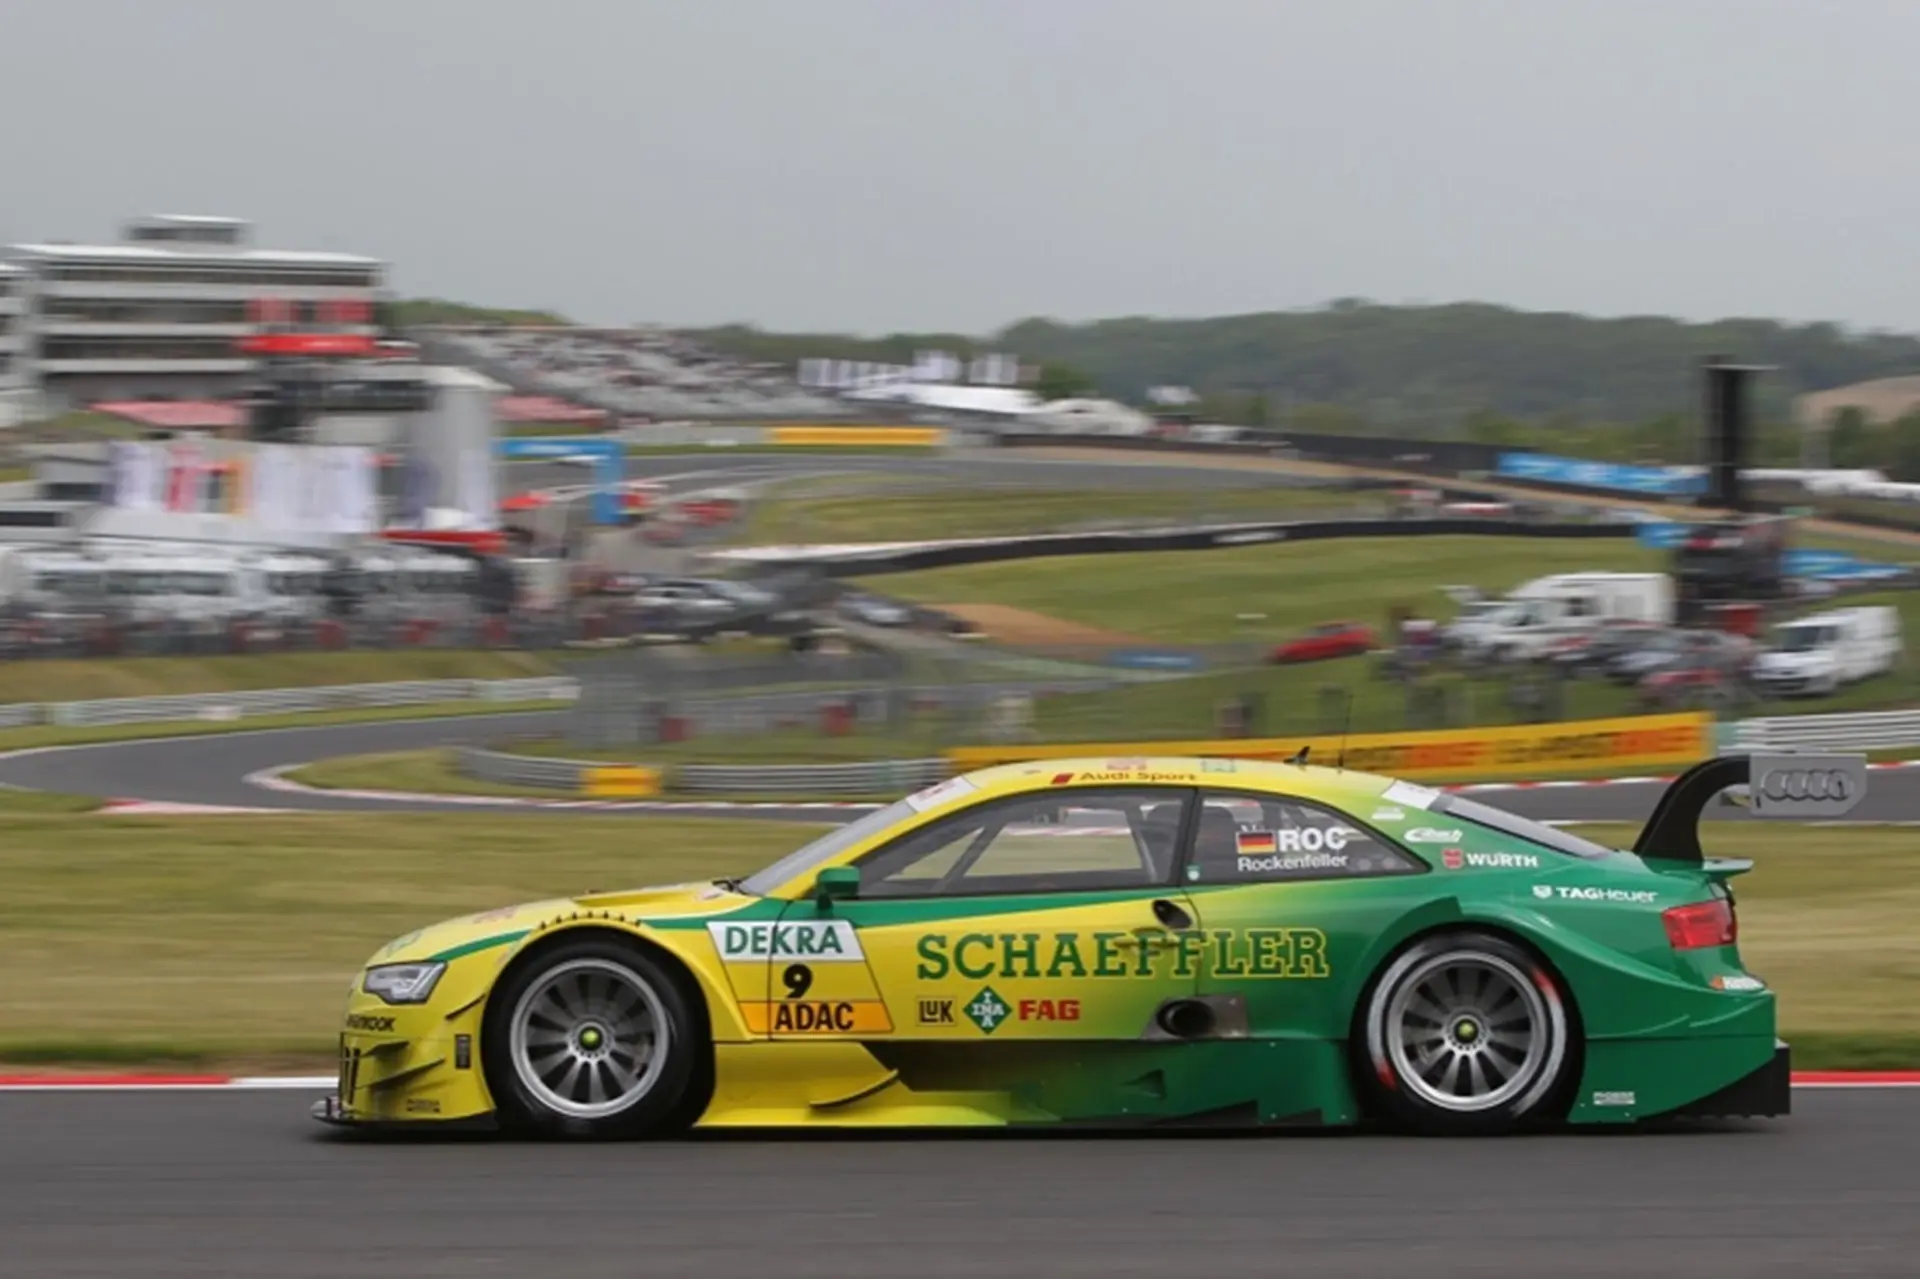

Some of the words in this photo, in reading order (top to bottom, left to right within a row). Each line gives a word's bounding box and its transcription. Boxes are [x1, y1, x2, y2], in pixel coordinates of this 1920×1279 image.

[1079, 771, 1130, 781] Audi
[1137, 773, 1196, 783] Sport
[1278, 828, 1348, 852] ROC
[1238, 855, 1349, 872] Rockenfeller
[725, 926, 844, 954] DEKRA
[916, 931, 1331, 979] SCHAEFFLER
[782, 963, 813, 999] 9
[775, 1002, 854, 1032] ADAC
[1018, 999, 1081, 1021] FAG
